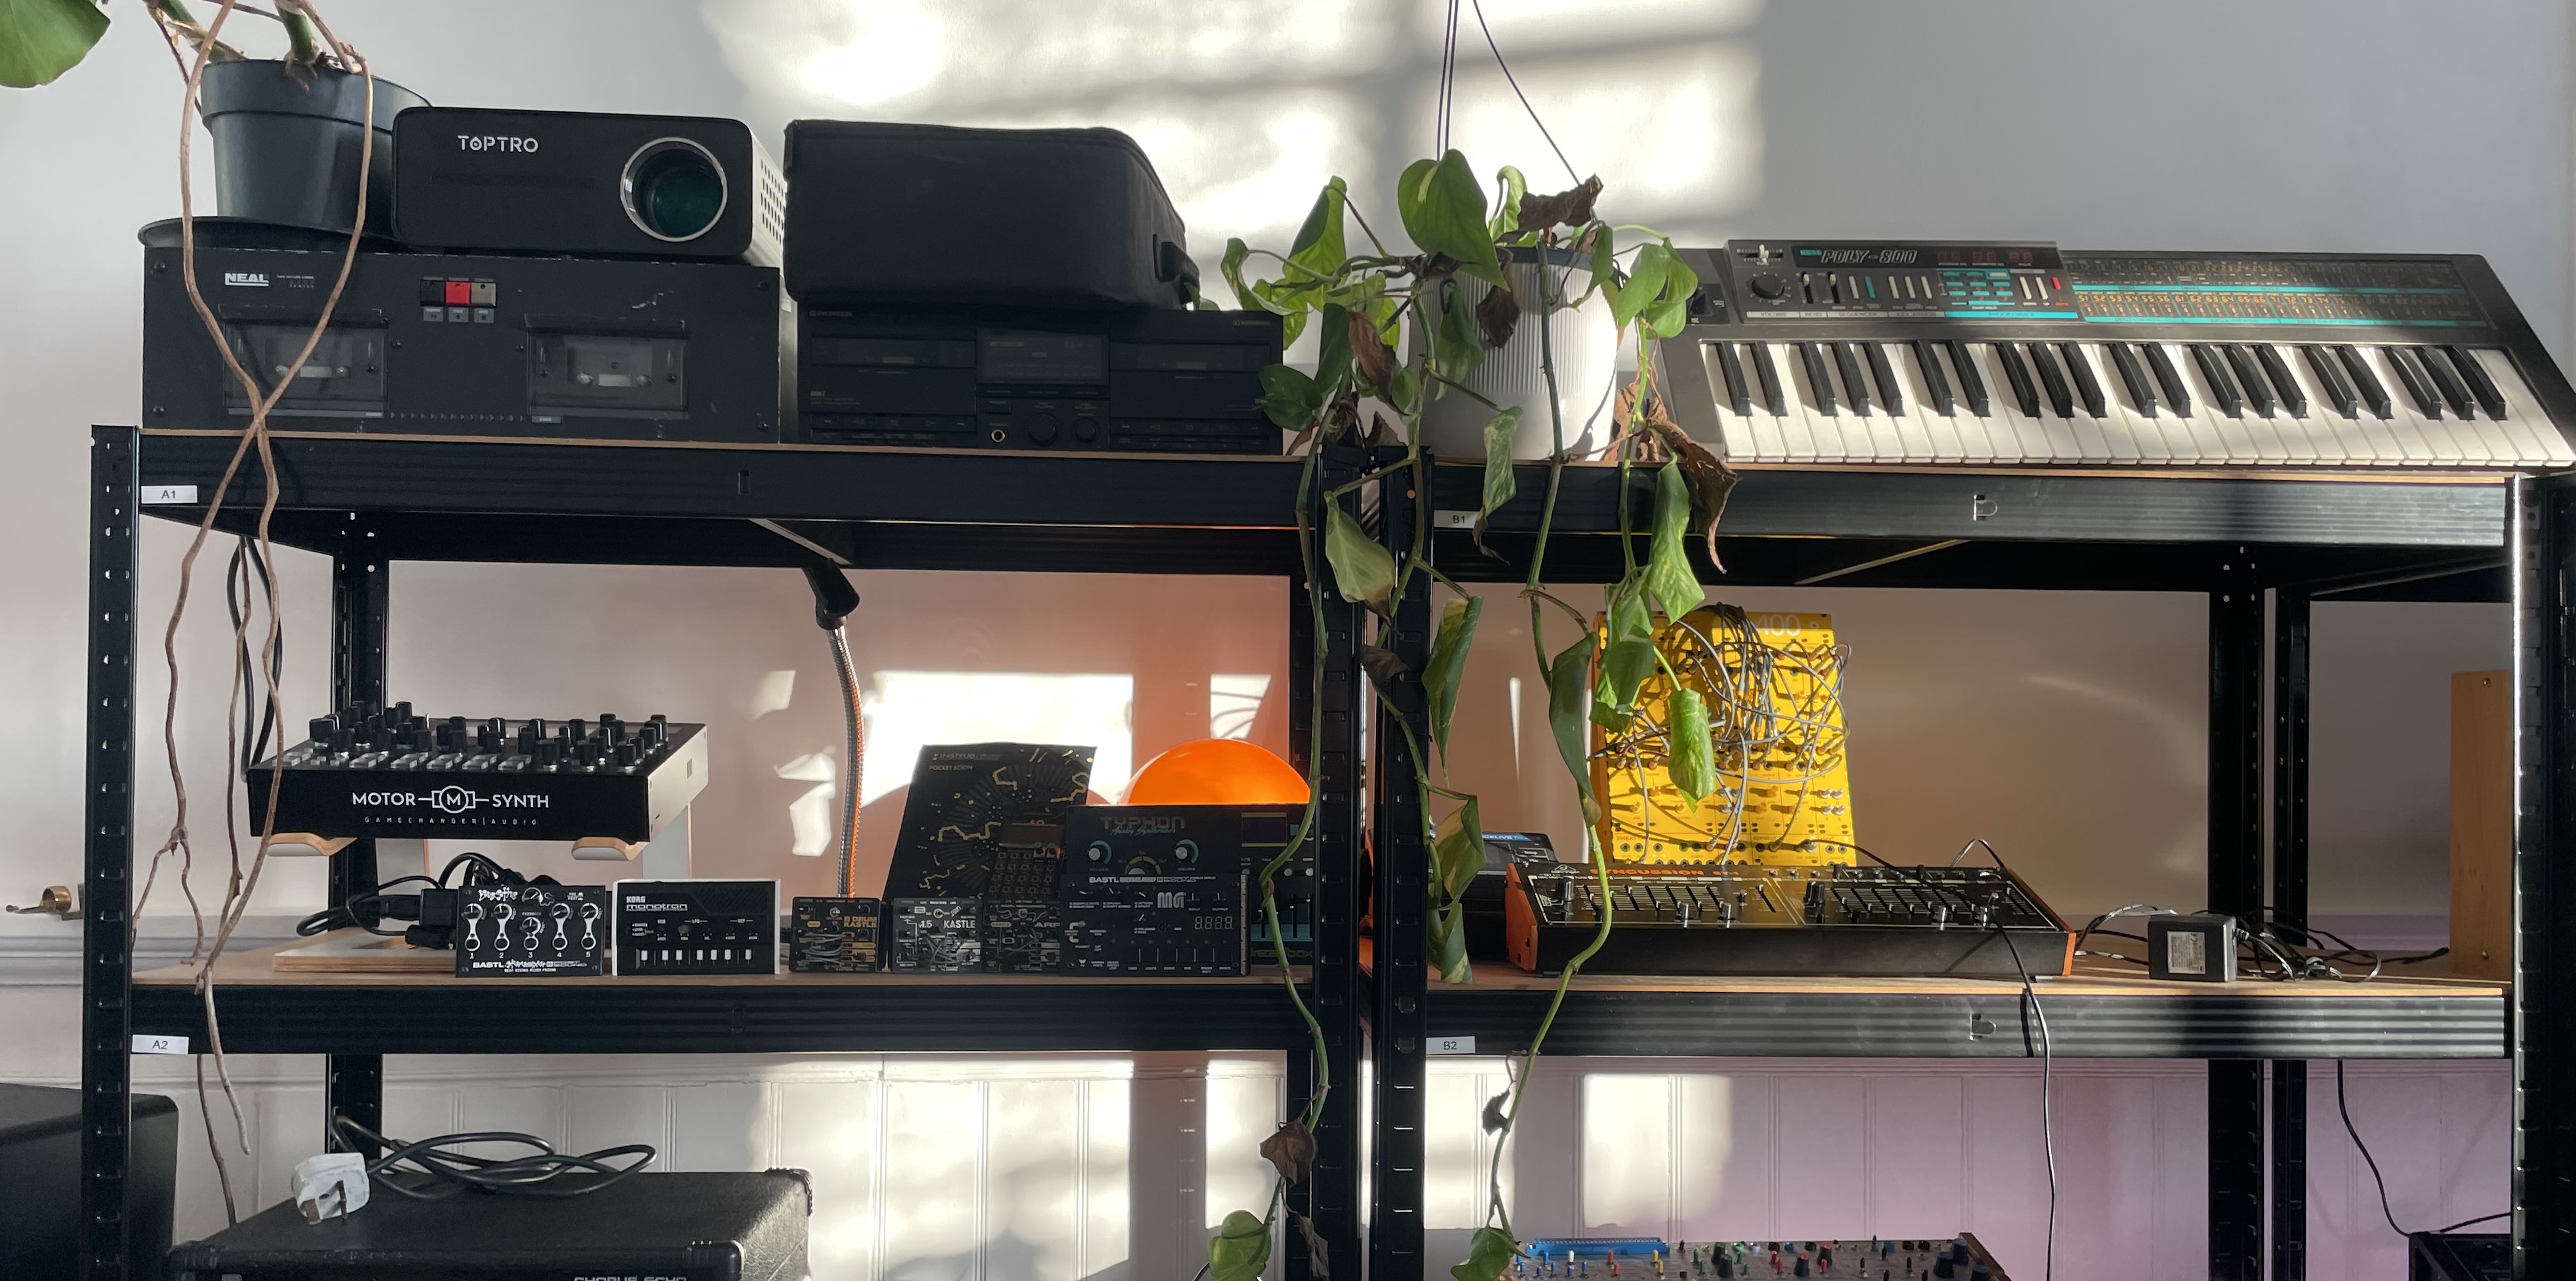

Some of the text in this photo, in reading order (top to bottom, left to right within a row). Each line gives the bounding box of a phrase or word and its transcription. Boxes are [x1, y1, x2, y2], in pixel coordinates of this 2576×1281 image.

[458, 135, 539, 153] TOPTRO
[1821, 250, 1918, 264] POLY-800
[225, 273, 269, 287] NEAL
[161, 490, 175, 499] A1
[1453, 514, 1465, 524] B1
[352, 792, 549, 808] MOTOR M SYNTH
[1101, 816, 1185, 829] TYPHON
[943, 920, 976, 928] KASTLE
[152, 1039, 168, 1049] A2
[1443, 1041, 1457, 1050] B2
